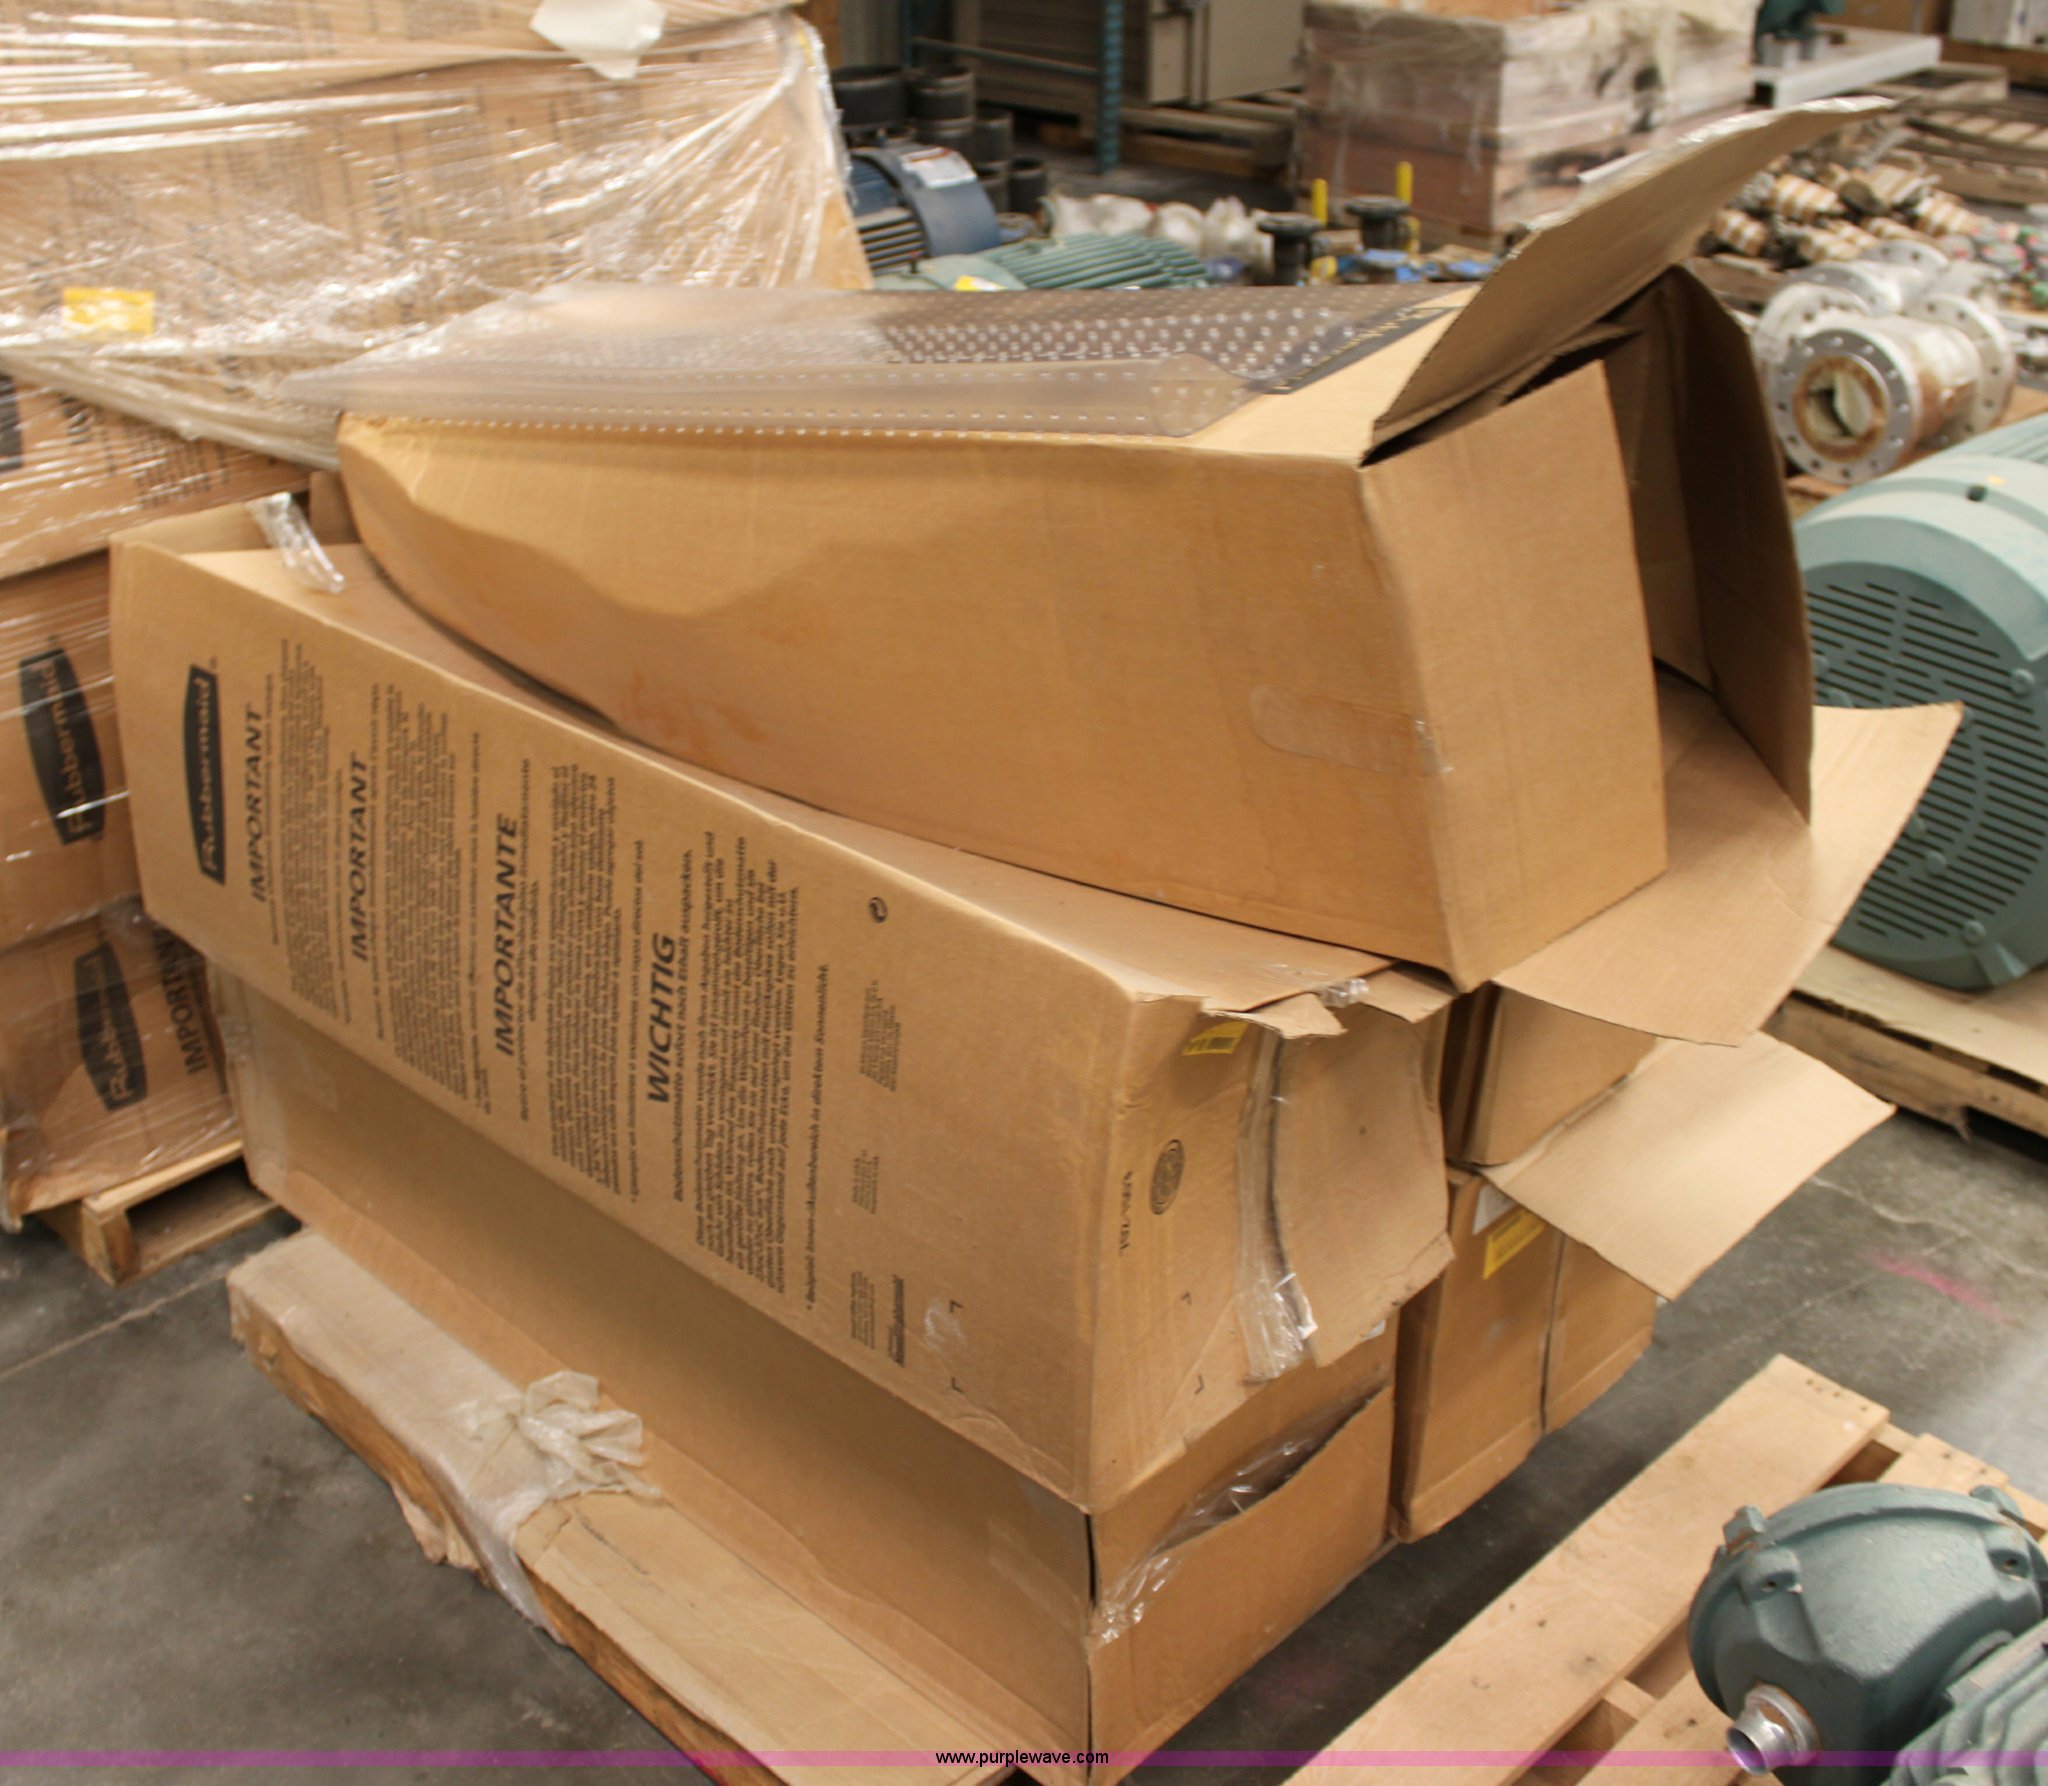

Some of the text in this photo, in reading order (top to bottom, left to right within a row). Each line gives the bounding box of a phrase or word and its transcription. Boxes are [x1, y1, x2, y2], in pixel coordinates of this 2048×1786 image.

[193, 676, 218, 870] Rubbermaid
[245, 702, 266, 902] IMPORTANT
[348, 752, 368, 961] IMPORTANT
[154, 937, 206, 1074] IMPORTAN
[494, 813, 516, 1056] IMPORTANTE
[646, 933, 675, 1102] WICHTIG
